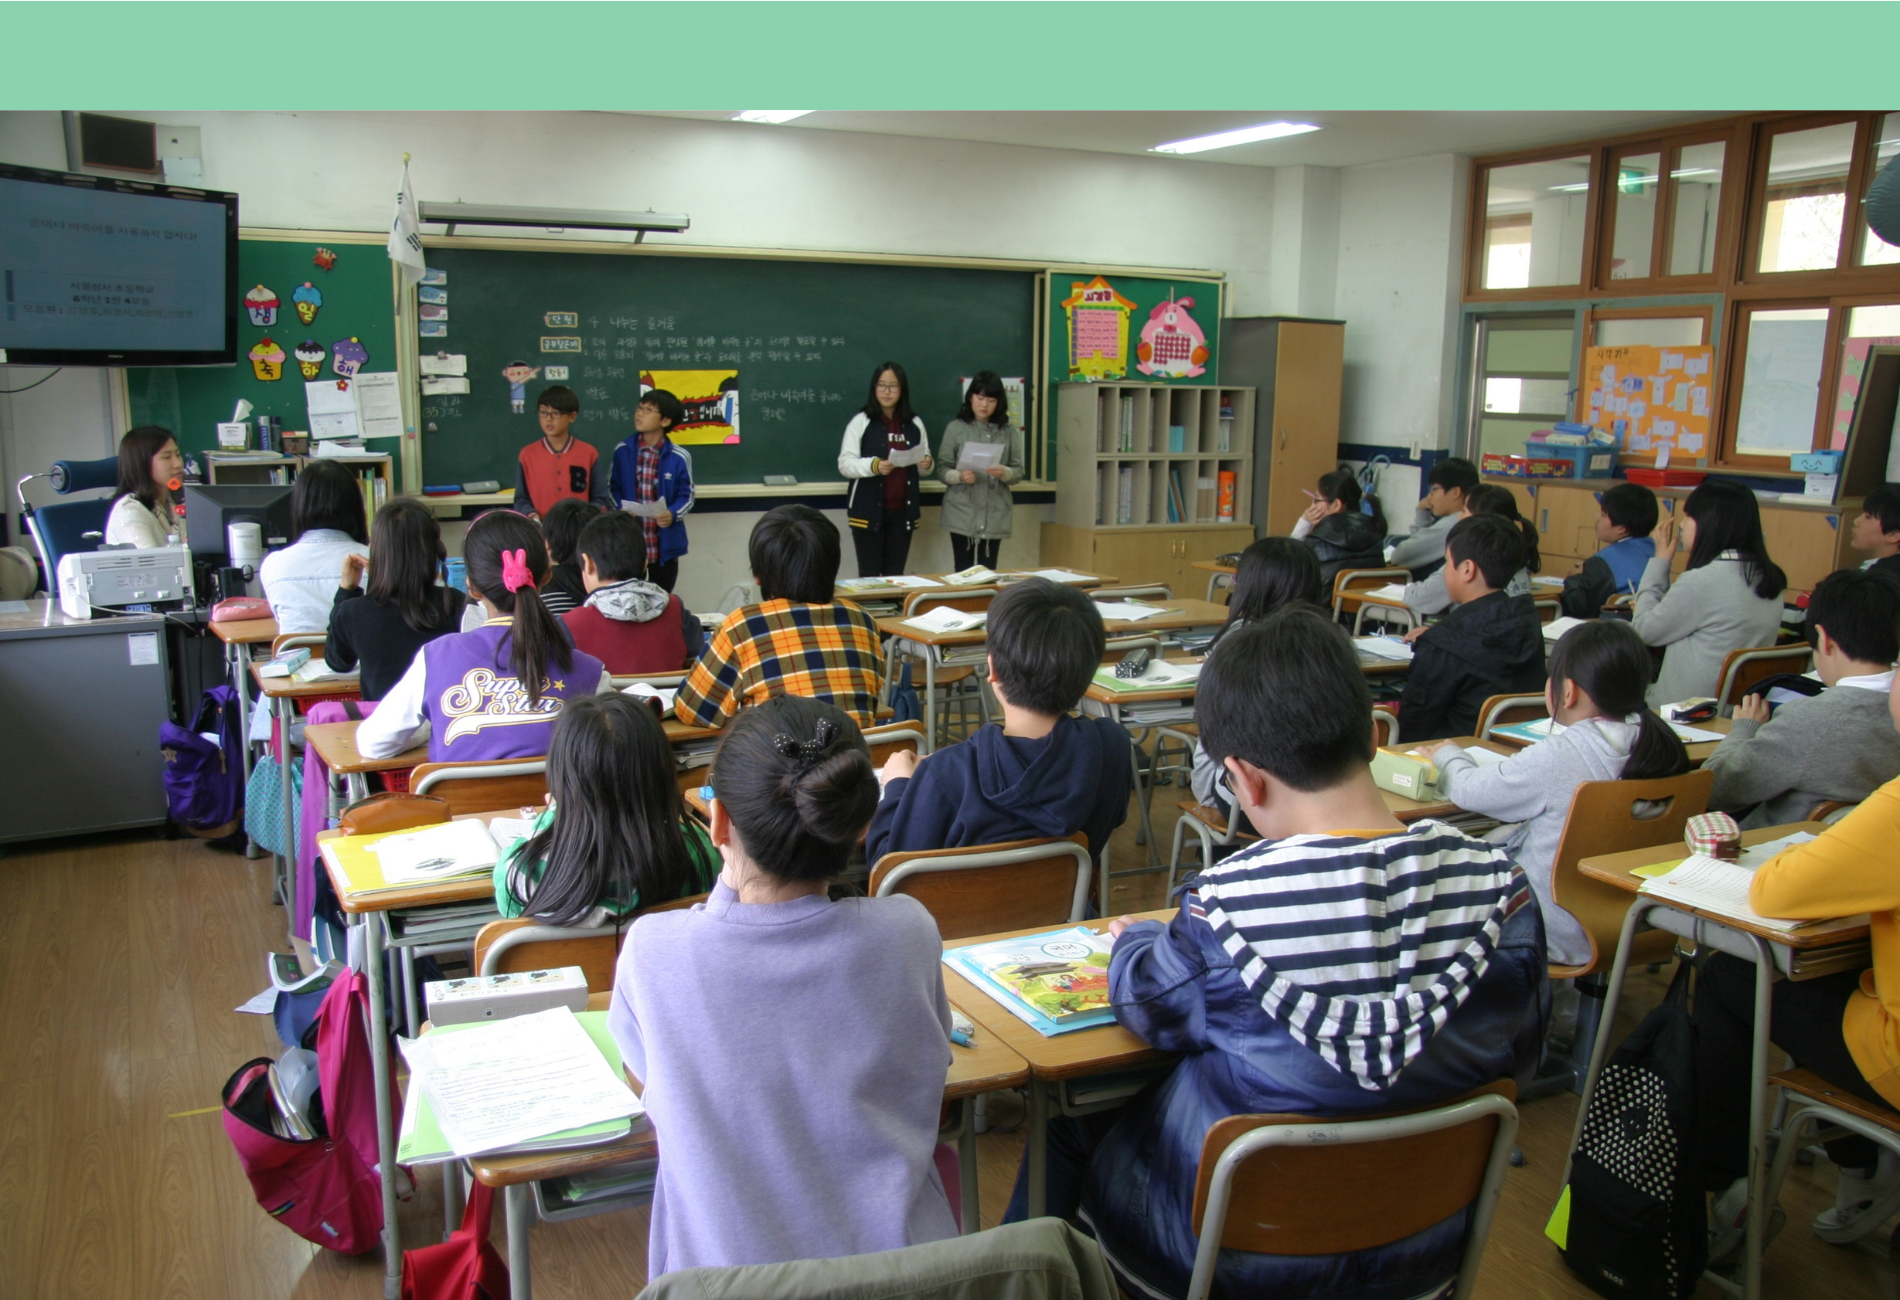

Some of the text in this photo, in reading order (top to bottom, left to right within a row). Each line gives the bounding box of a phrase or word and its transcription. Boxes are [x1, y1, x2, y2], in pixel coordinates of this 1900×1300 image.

[72, 294, 102, 305] 6학년
[569, 465, 588, 493] B
[441, 668, 551, 715] Sup
